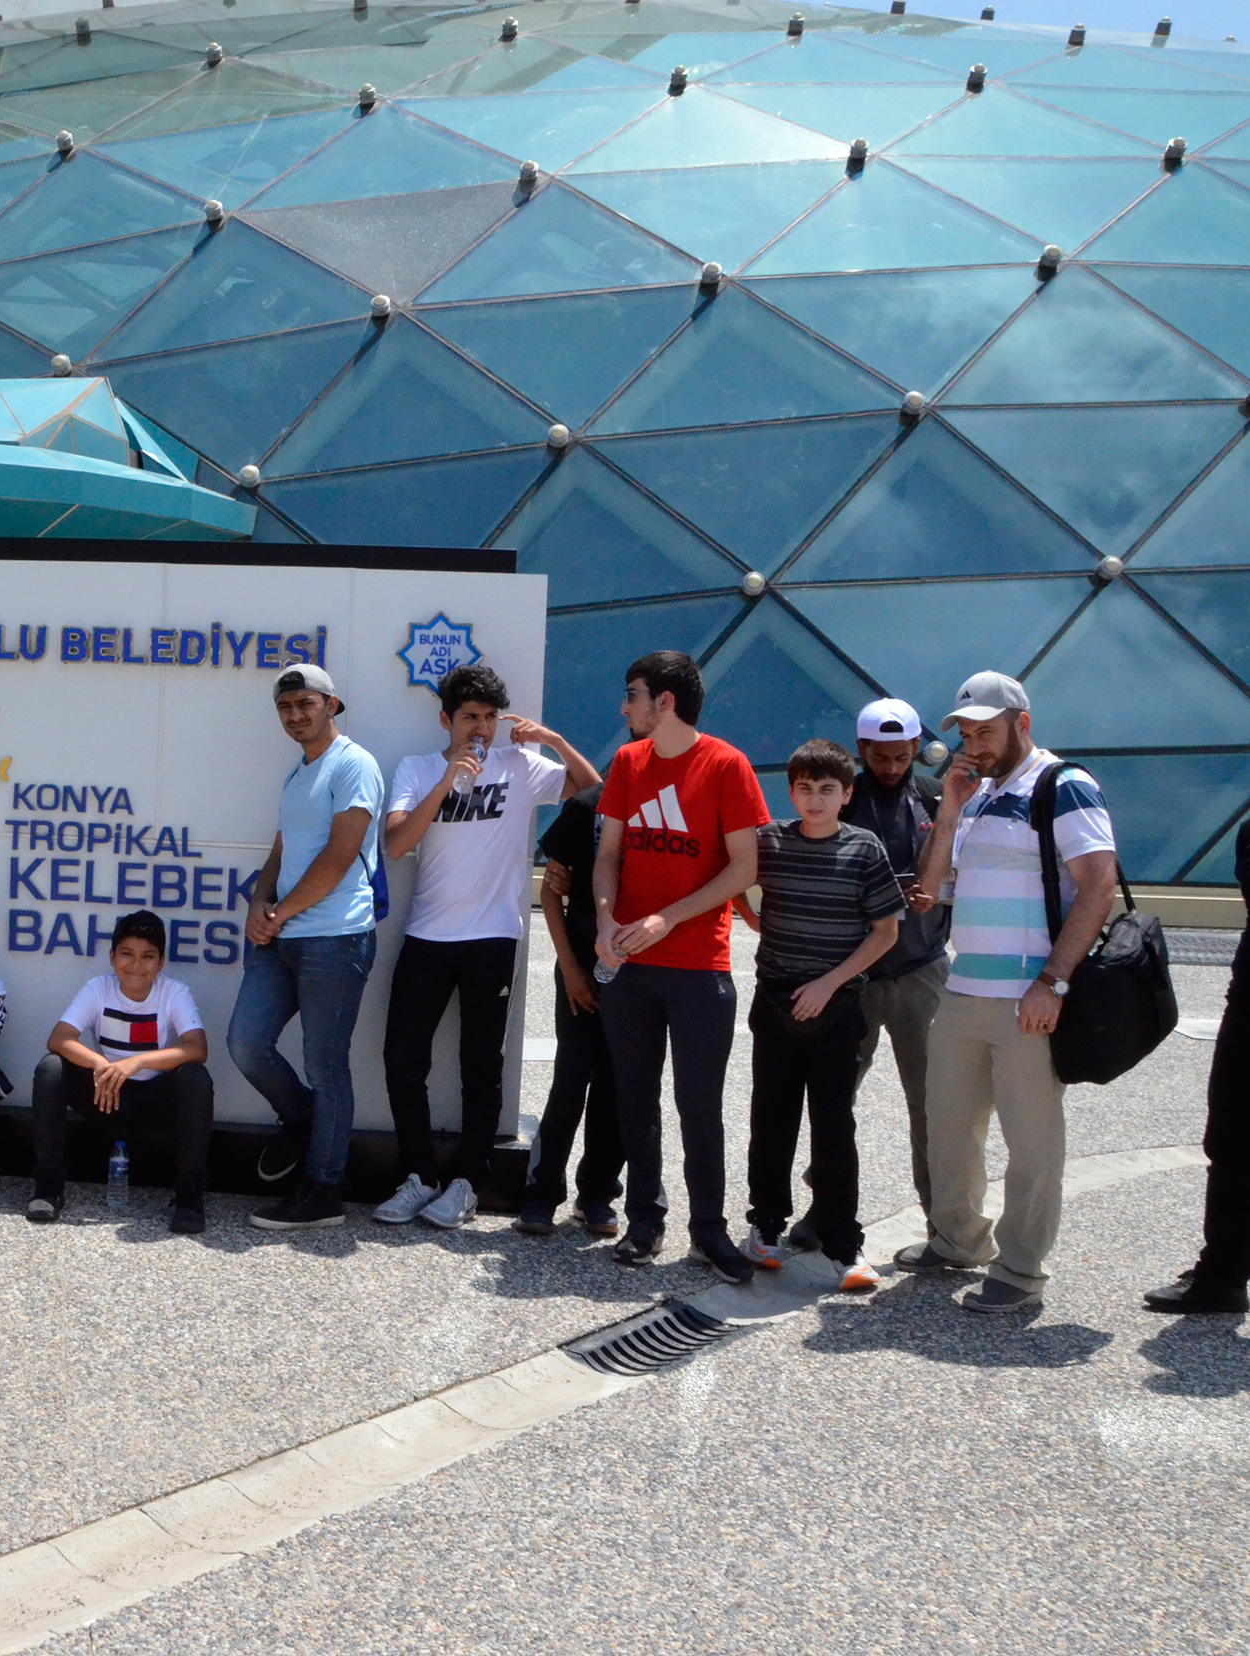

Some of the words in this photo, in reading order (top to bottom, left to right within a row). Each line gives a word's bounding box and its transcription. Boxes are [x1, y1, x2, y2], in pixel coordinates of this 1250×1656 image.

[60, 622, 327, 670] BELEDİYESİ
[419, 634, 461, 645] BUNUN
[430, 647, 451, 657] ADI
[12, 782, 135, 816] KONYA
[432, 781, 510, 823] NIKE
[625, 826, 701, 858] adidas
[9, 856, 263, 911] KELEBEK
[7, 908, 252, 966] BAHES
